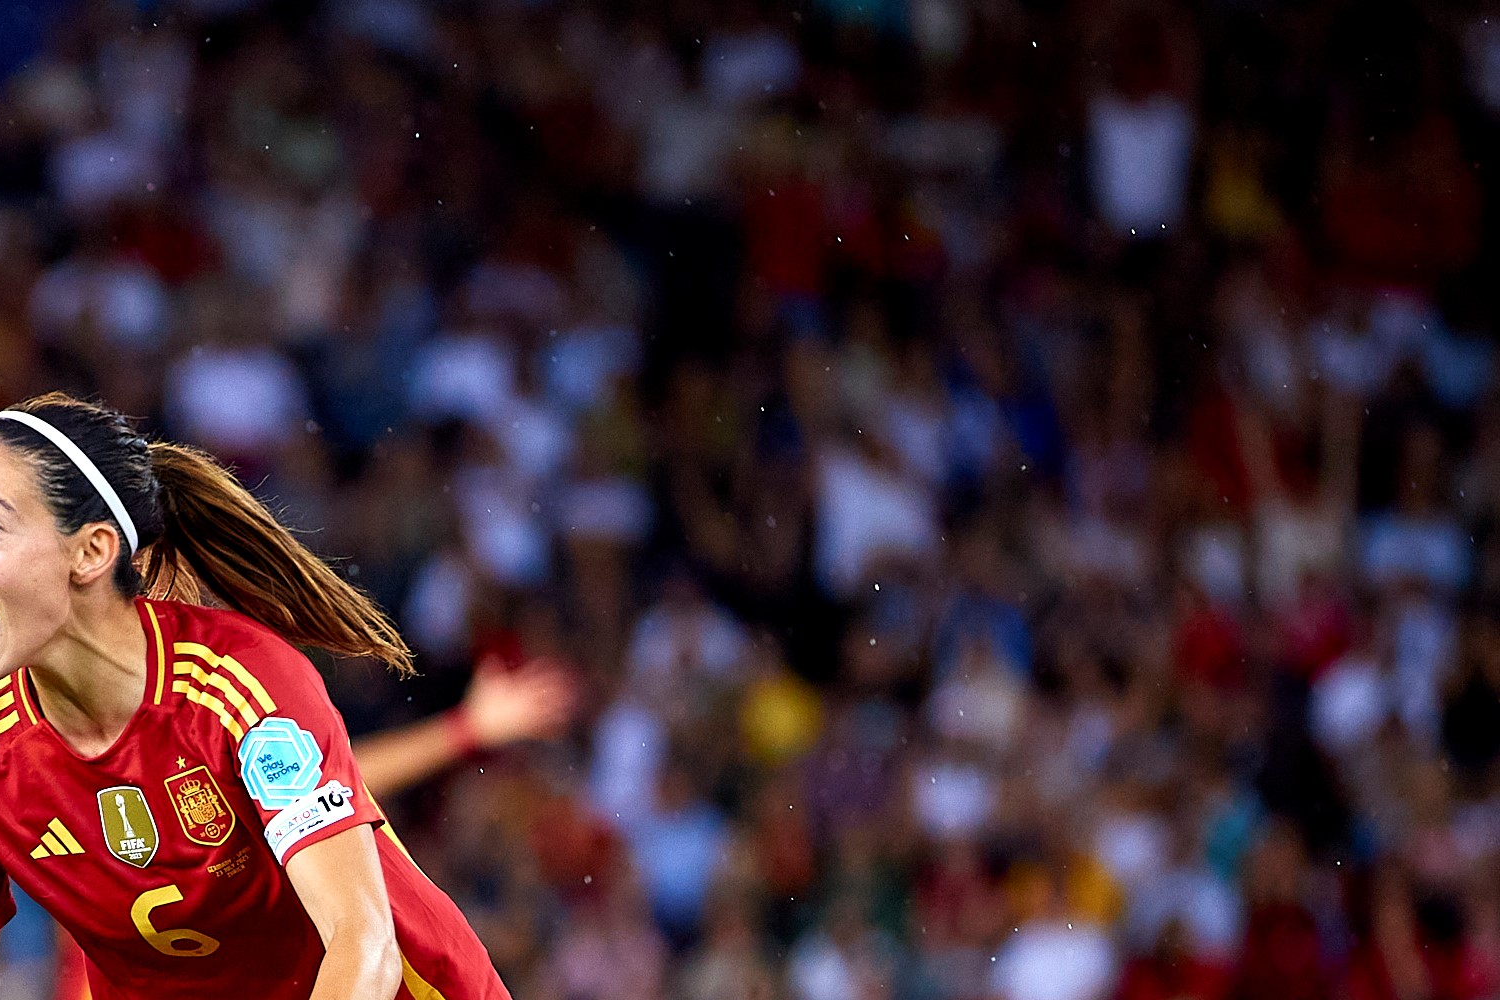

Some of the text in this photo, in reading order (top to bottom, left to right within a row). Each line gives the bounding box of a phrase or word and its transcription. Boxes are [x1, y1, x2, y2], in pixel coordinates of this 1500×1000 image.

[257, 754, 272, 764] We
[120, 838, 145, 850] FIFA
[130, 884, 220, 957] 6
